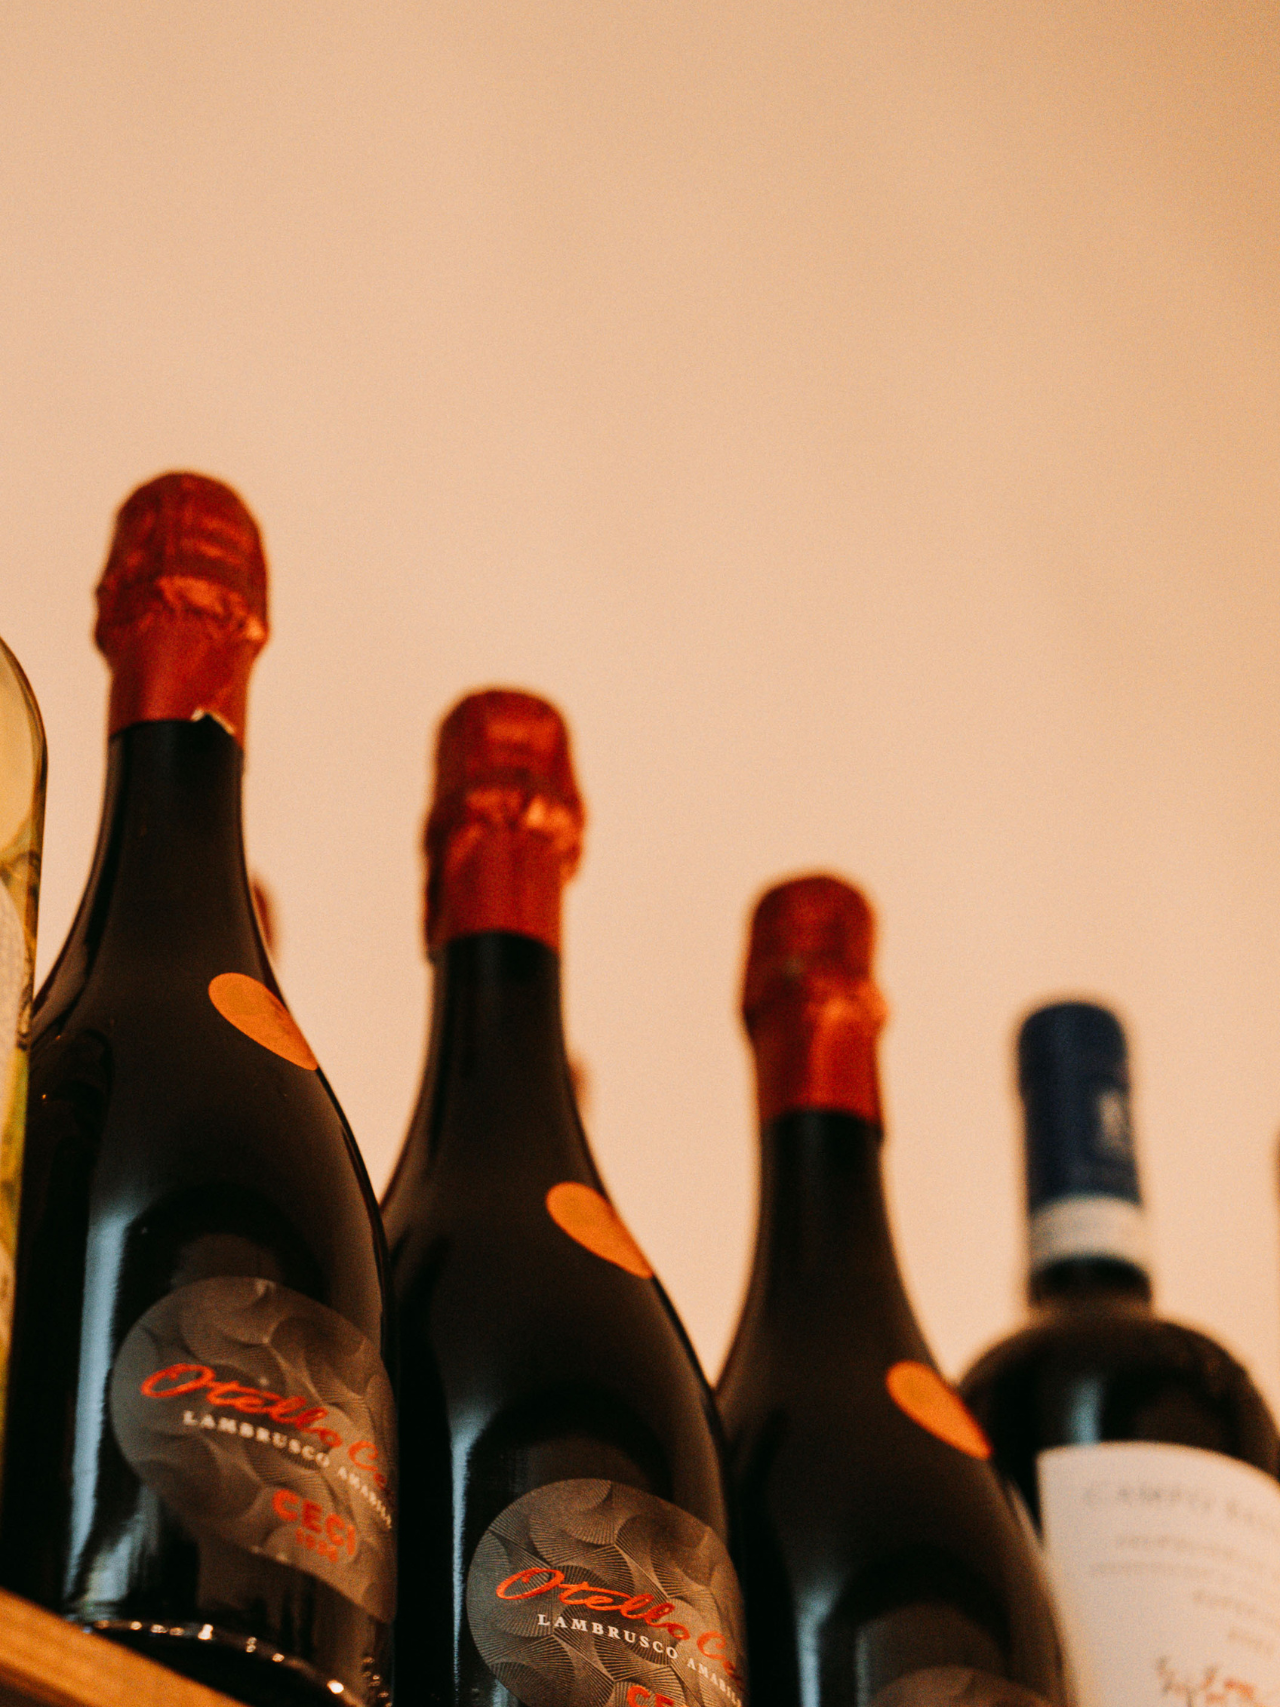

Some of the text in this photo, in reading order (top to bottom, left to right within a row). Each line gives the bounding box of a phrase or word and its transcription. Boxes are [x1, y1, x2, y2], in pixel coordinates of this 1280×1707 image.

[182, 1410, 330, 1468] LAMBRUSCO
[271, 1488, 356, 1556] CECI
[495, 1566, 692, 1641] Otello
[536, 1612, 679, 1660] LAMBRUSCO
